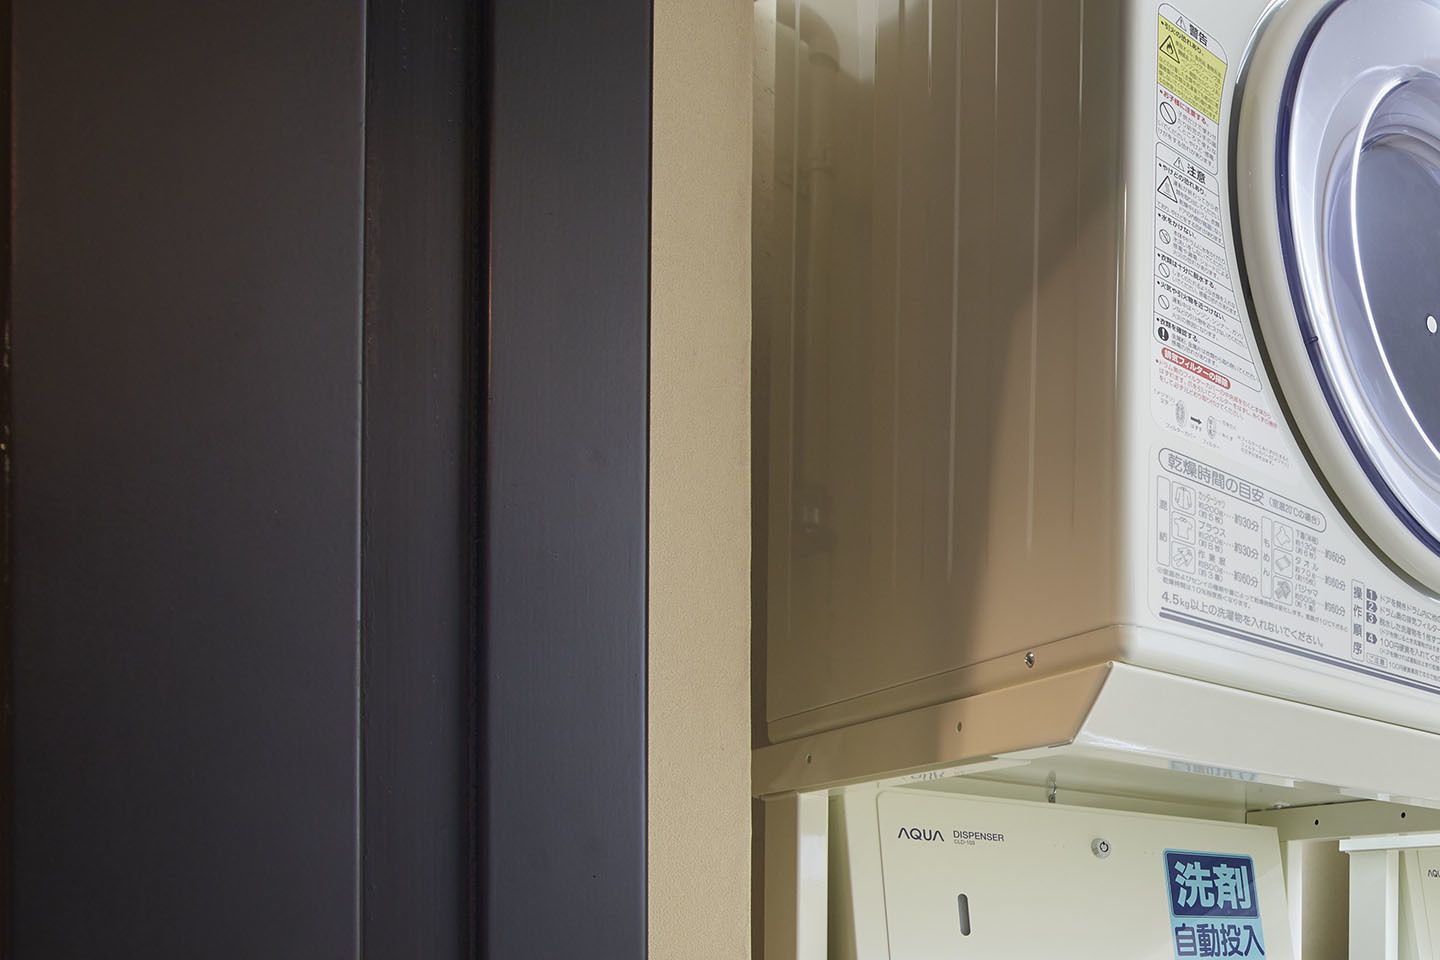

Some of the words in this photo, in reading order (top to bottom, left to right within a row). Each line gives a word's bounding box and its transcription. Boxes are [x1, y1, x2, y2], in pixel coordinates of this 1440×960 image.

[1187, 162, 1206, 185] 注意
[1167, 453, 1264, 506] 乾燥時間の目安
[898, 827, 944, 842] AQUA
[953, 830, 1004, 842] DISPENSER
[1174, 861, 1252, 909] 洗剤
[1174, 922, 1265, 957] 自動投入
